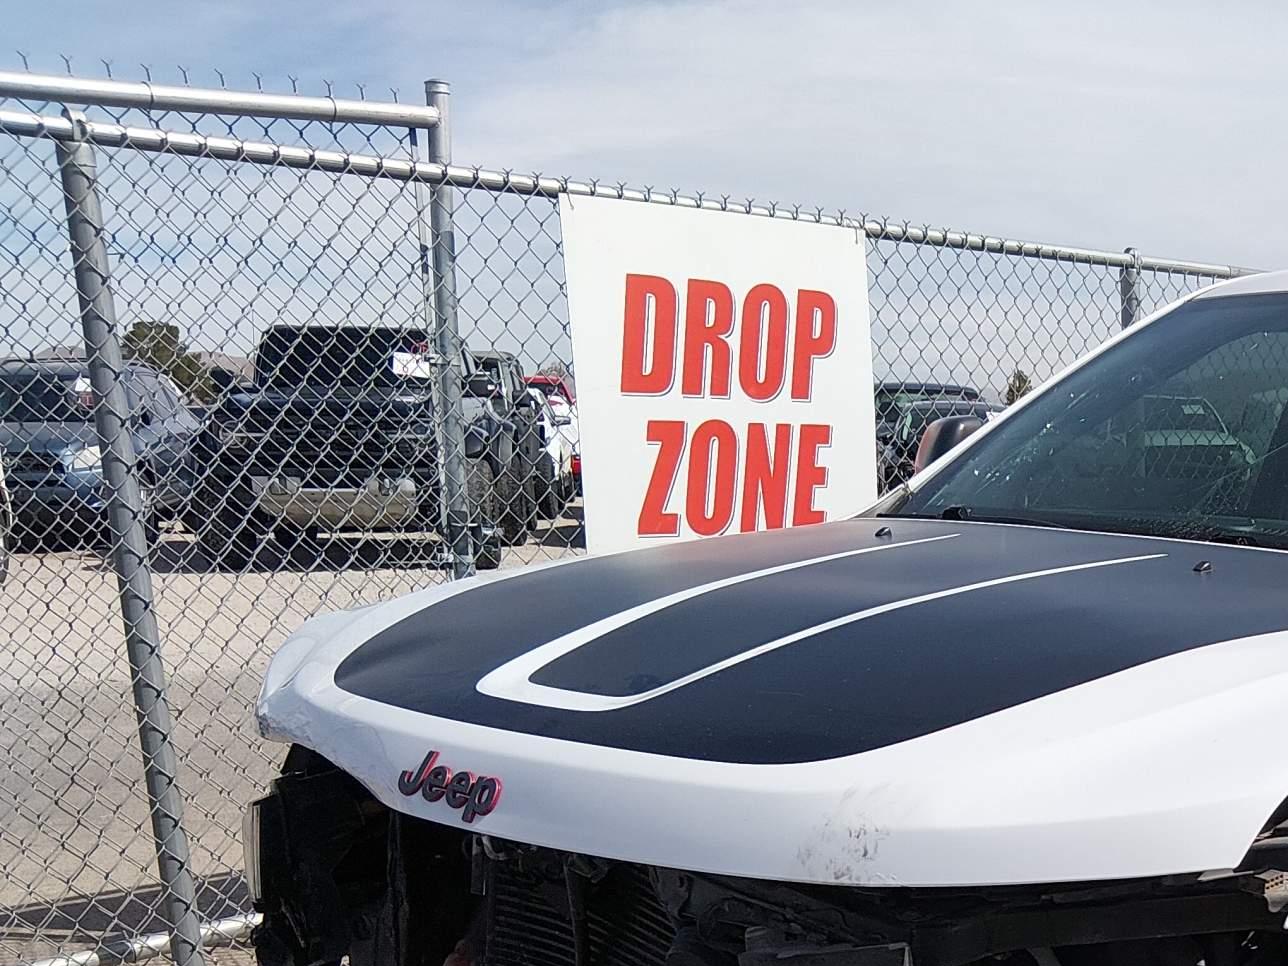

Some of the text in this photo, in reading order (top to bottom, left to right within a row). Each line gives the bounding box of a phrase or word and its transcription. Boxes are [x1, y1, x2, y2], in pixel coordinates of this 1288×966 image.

[621, 273, 838, 403] DROP
[637, 418, 833, 539] ZONE
[398, 750, 502, 823] Jeep
